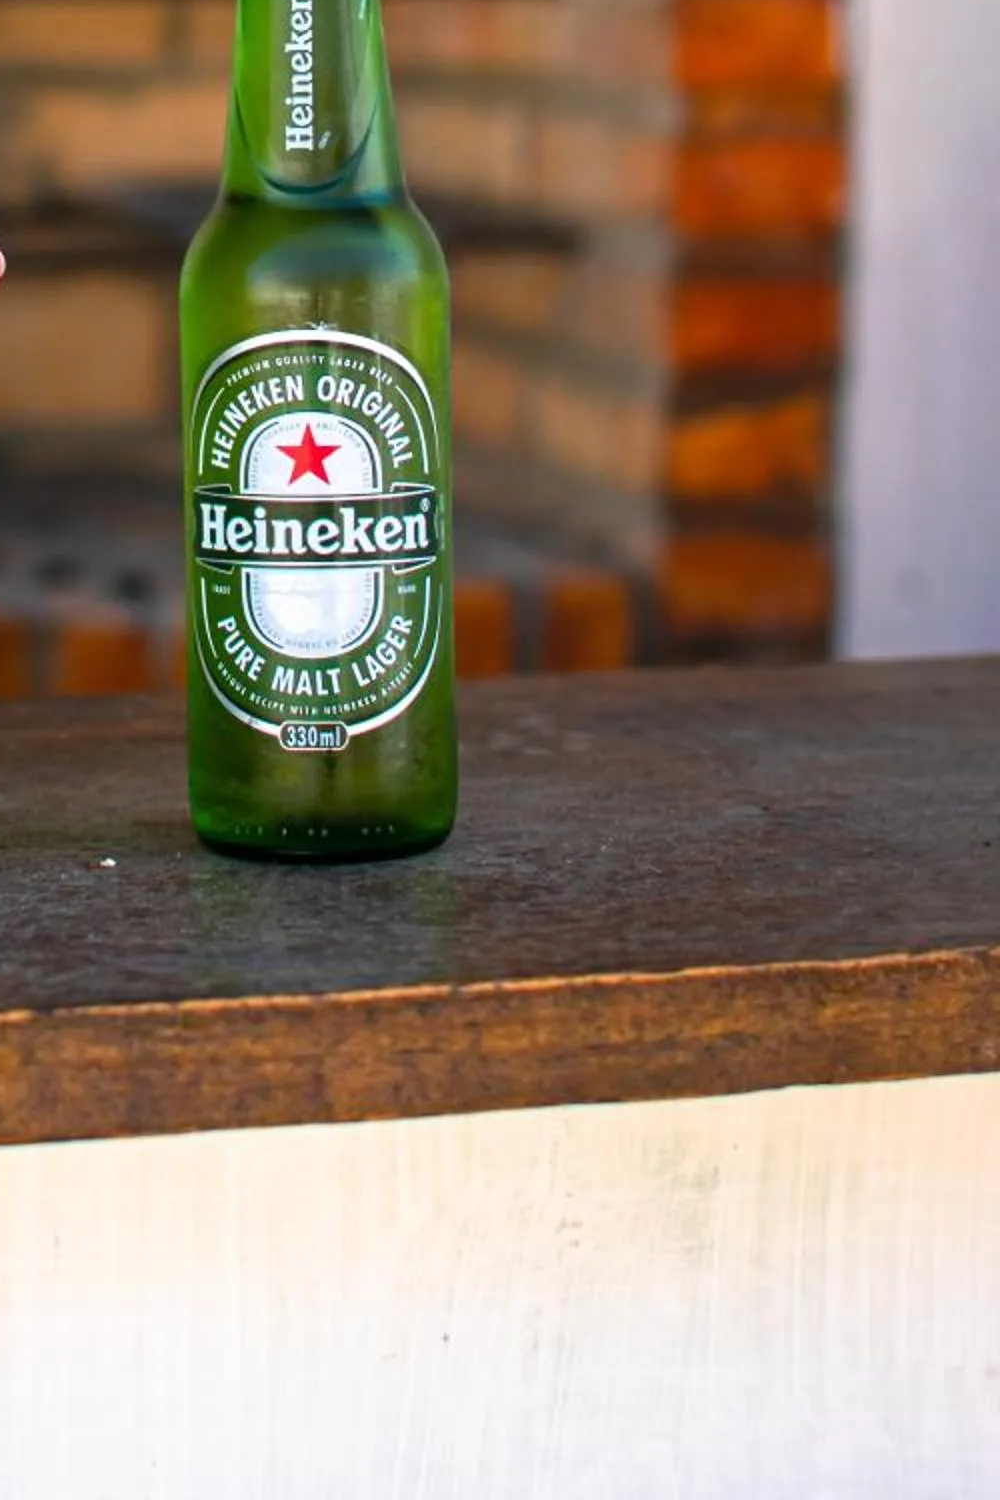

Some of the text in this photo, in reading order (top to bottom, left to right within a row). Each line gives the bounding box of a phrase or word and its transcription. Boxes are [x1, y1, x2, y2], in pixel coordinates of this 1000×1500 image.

[211, 374, 305, 469] HEINEKEN
[317, 374, 413, 469] ORIGINAL
[200, 502, 430, 555] Heineken
[217, 614, 413, 696] PURE MALT LAGER
[286, 726, 341, 747] 330ml
